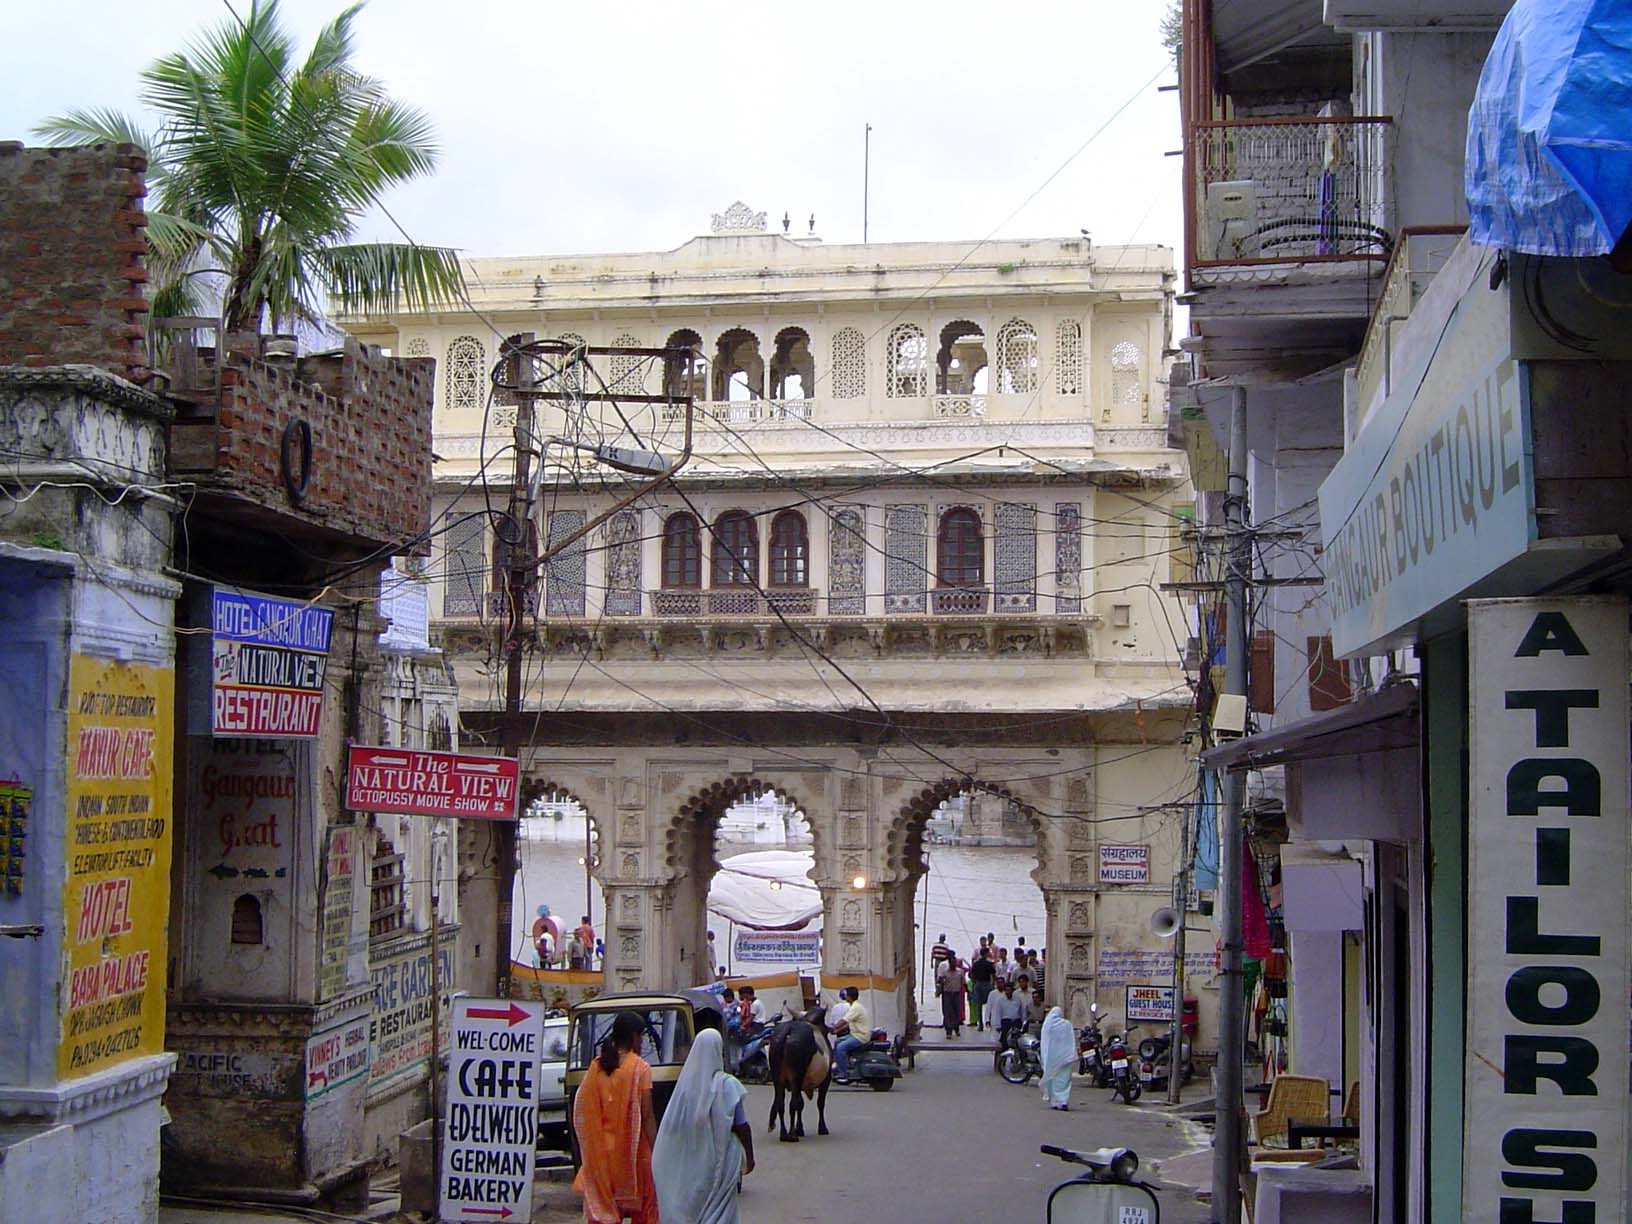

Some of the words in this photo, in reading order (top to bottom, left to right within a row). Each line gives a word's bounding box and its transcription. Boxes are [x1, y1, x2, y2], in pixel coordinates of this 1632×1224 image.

[1326, 490, 1392, 620] GANGAUR
[1389, 360, 1520, 577] BOUTIQUE
[216, 600, 256, 635] HOTEL
[257, 602, 304, 645] GANGAUR
[305, 610, 332, 649] GHAT
[1514, 611, 1590, 657] A
[240, 648, 292, 686] NATURAL
[294, 655, 327, 688] VIEW
[215, 688, 322, 732] RESTAURANT
[76, 727, 120, 779] MAYUR
[121, 728, 155, 779] CAFE
[415, 754, 449, 774] The
[352, 789, 414, 806] OCTOPUSSY
[416, 794, 450, 809] MOVIE
[454, 798, 489, 812] SHOW
[354, 767, 454, 794] NATURAL
[460, 775, 511, 798] VIEW
[1101, 848, 1147, 861] संग्रहालय
[1101, 869, 1147, 880] MUSEUM
[77, 878, 132, 942] HOTEL
[1503, 688, 1601, 1097] TAILOR
[71, 962, 101, 1010] BABA
[102, 951, 149, 1001] PALACE
[1133, 989, 1160, 999] JHEEL
[1129, 999, 1152, 1009] GUEST
[457, 1029, 536, 1053] WEL-COME
[458, 1058, 533, 1100] CAFE
[449, 1103, 536, 1145] EDELWEISS
[450, 1148, 527, 1177] GERMAN
[447, 1176, 525, 1204] BAKERY
